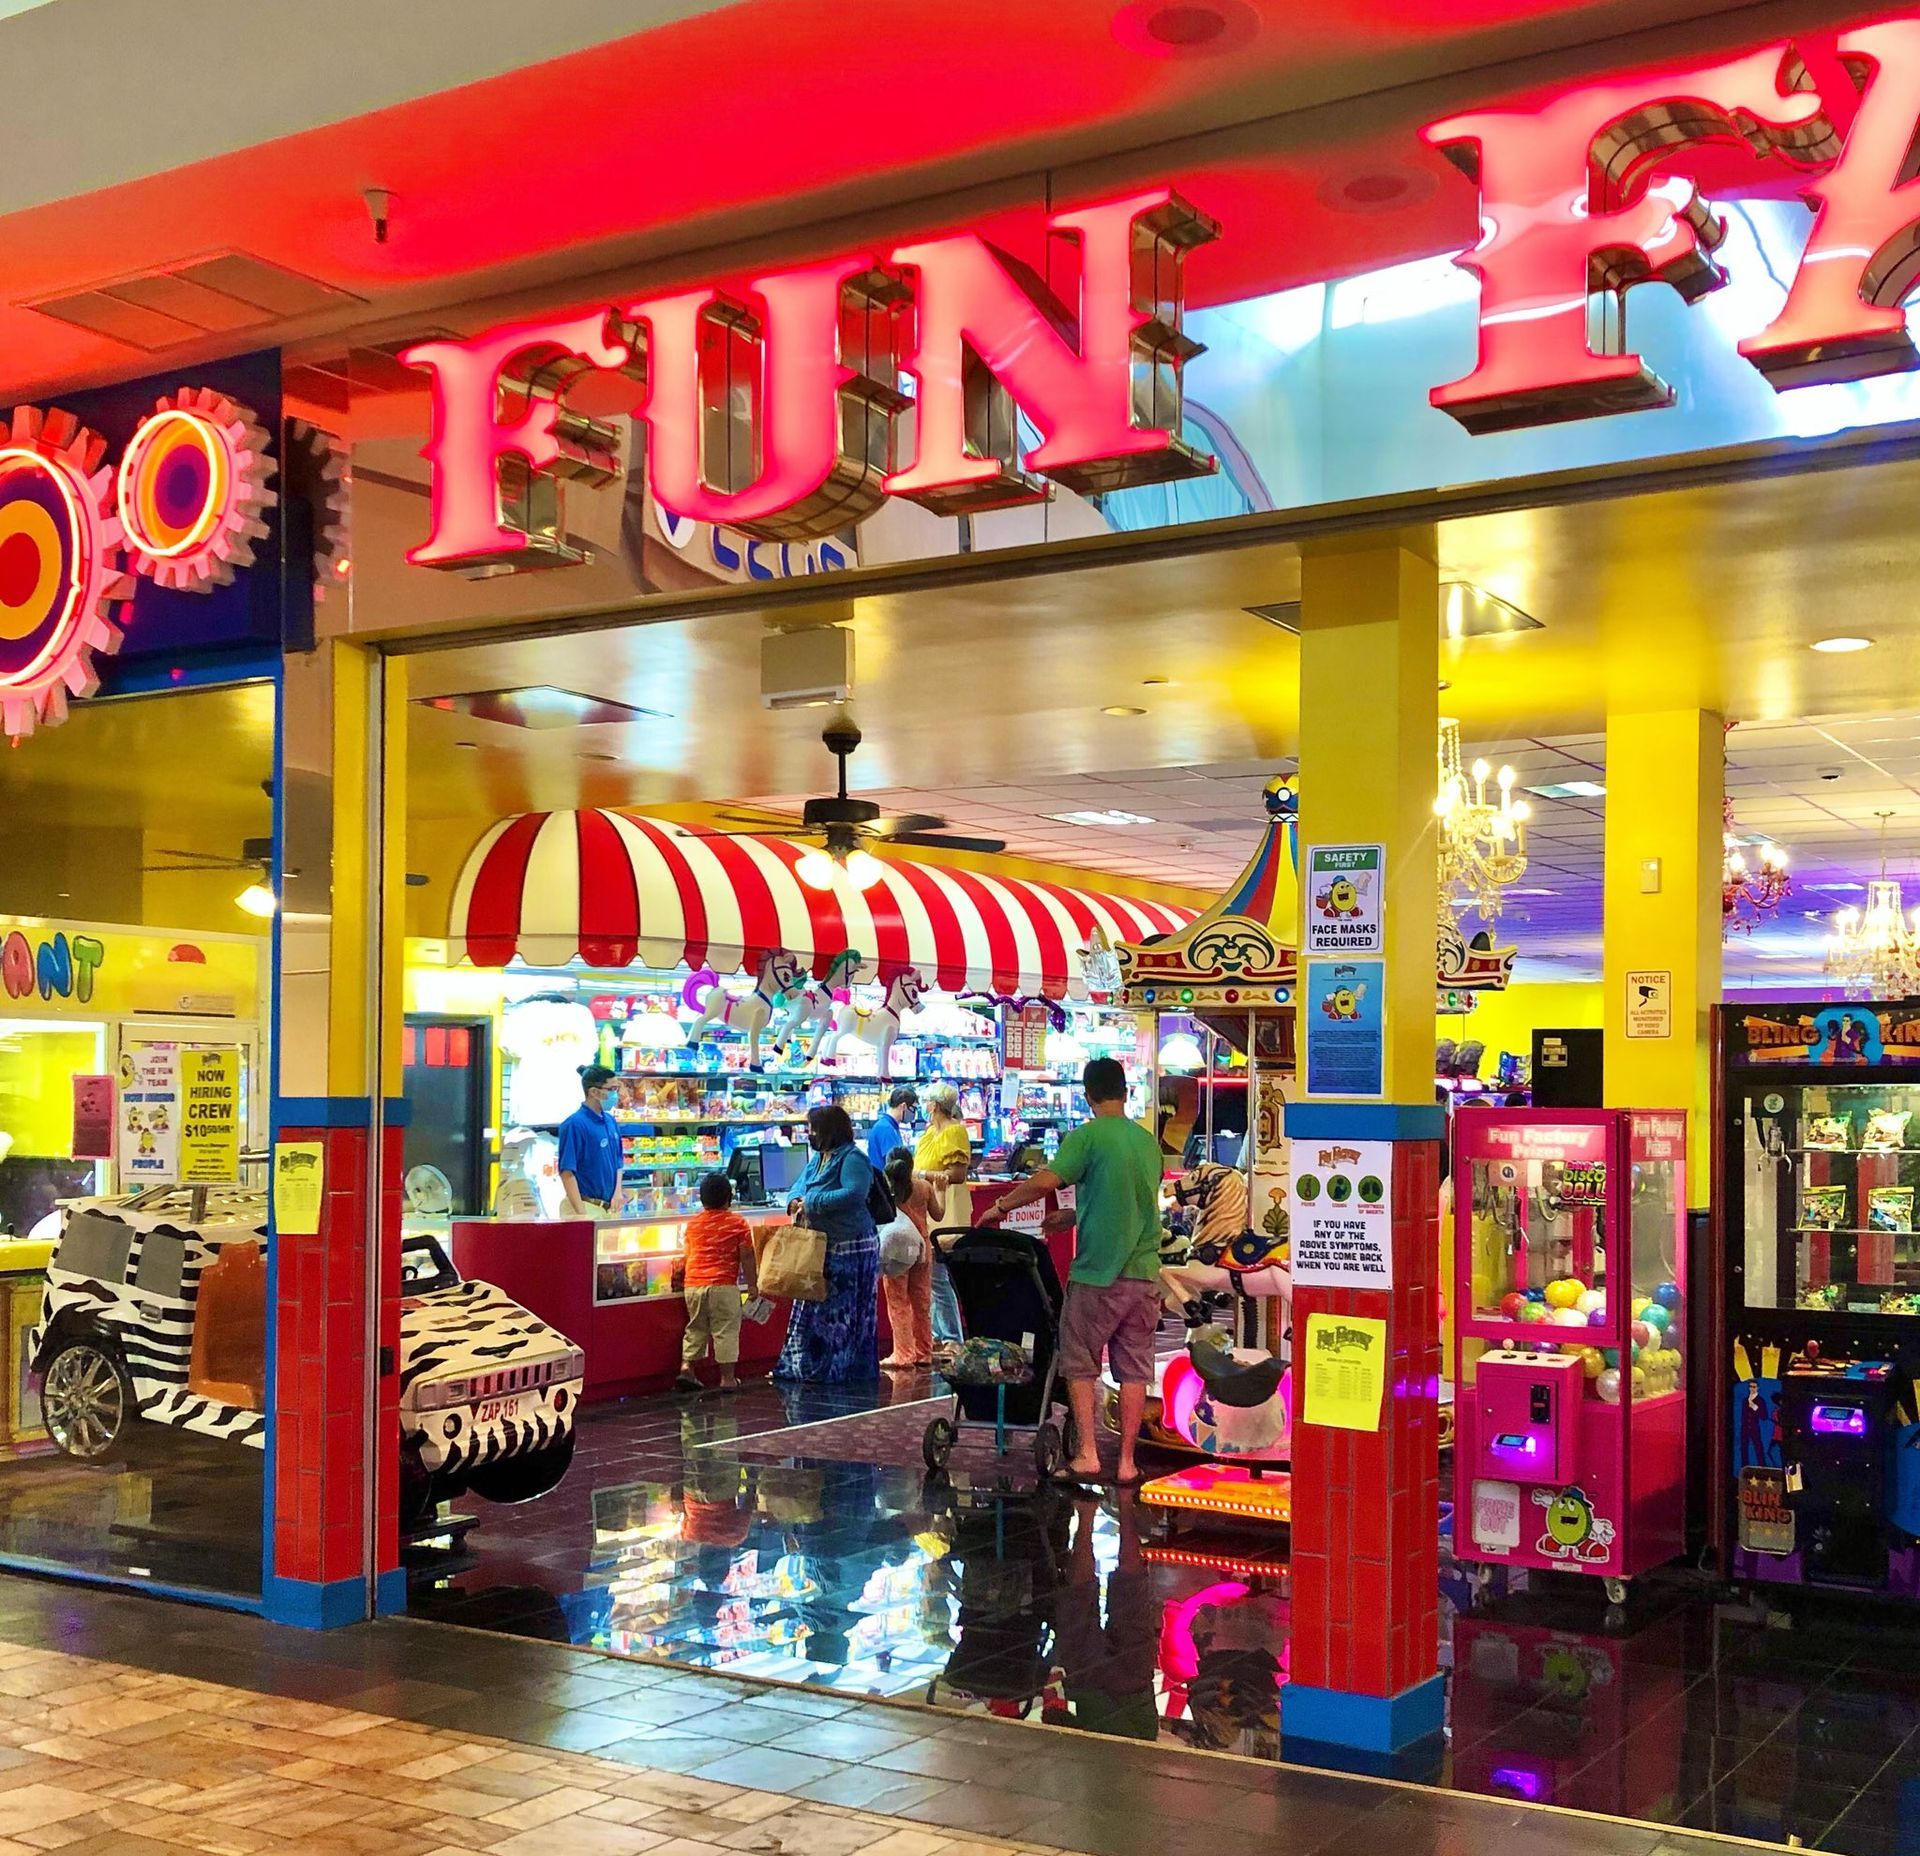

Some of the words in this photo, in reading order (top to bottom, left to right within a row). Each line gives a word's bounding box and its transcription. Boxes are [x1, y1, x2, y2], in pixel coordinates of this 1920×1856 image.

[403, 187, 1205, 572] FUN
[1324, 852, 1367, 862] SAFETY
[1312, 925, 1337, 934] FACE
[1340, 924, 1377, 934] MASKS
[1316, 937, 1372, 947] REQUIRED
[0, 930, 105, 1004] ANT
[1631, 975, 1666, 984] NOTICE
[1747, 1025, 1820, 1044] BLING
[197, 1070, 225, 1082] NOW
[190, 1087, 232, 1098] HIRING
[188, 1104, 232, 1118] CREW
[1488, 1128, 1519, 1143] Fun
[1522, 1128, 1590, 1148] Factory
[1564, 1169, 1606, 1182] DISCO
[1016, 1211, 1044, 1222] DOING?
[1324, 1220, 1340, 1229] YOU
[1344, 1222, 1366, 1230] HAVE
[1314, 1230, 1331, 1238] ANY
[1348, 1232, 1365, 1240] THE
[1300, 1240, 1326, 1249] ABOVE
[1299, 1250, 1330, 1260] PLEASE
[1333, 1252, 1357, 1261] COME
[1360, 1253, 1382, 1262] BACK
[1296, 1260, 1321, 1270] WHEN
[1324, 1262, 1340, 1270] YOU
[1343, 1262, 1360, 1272] ARE
[1362, 1263, 1386, 1272] WELL
[481, 1402, 500, 1422] ZAP
[504, 1398, 518, 1418] 161
[1743, 1489, 1781, 1505] BLIN
[1744, 1504, 1792, 1524] KING
